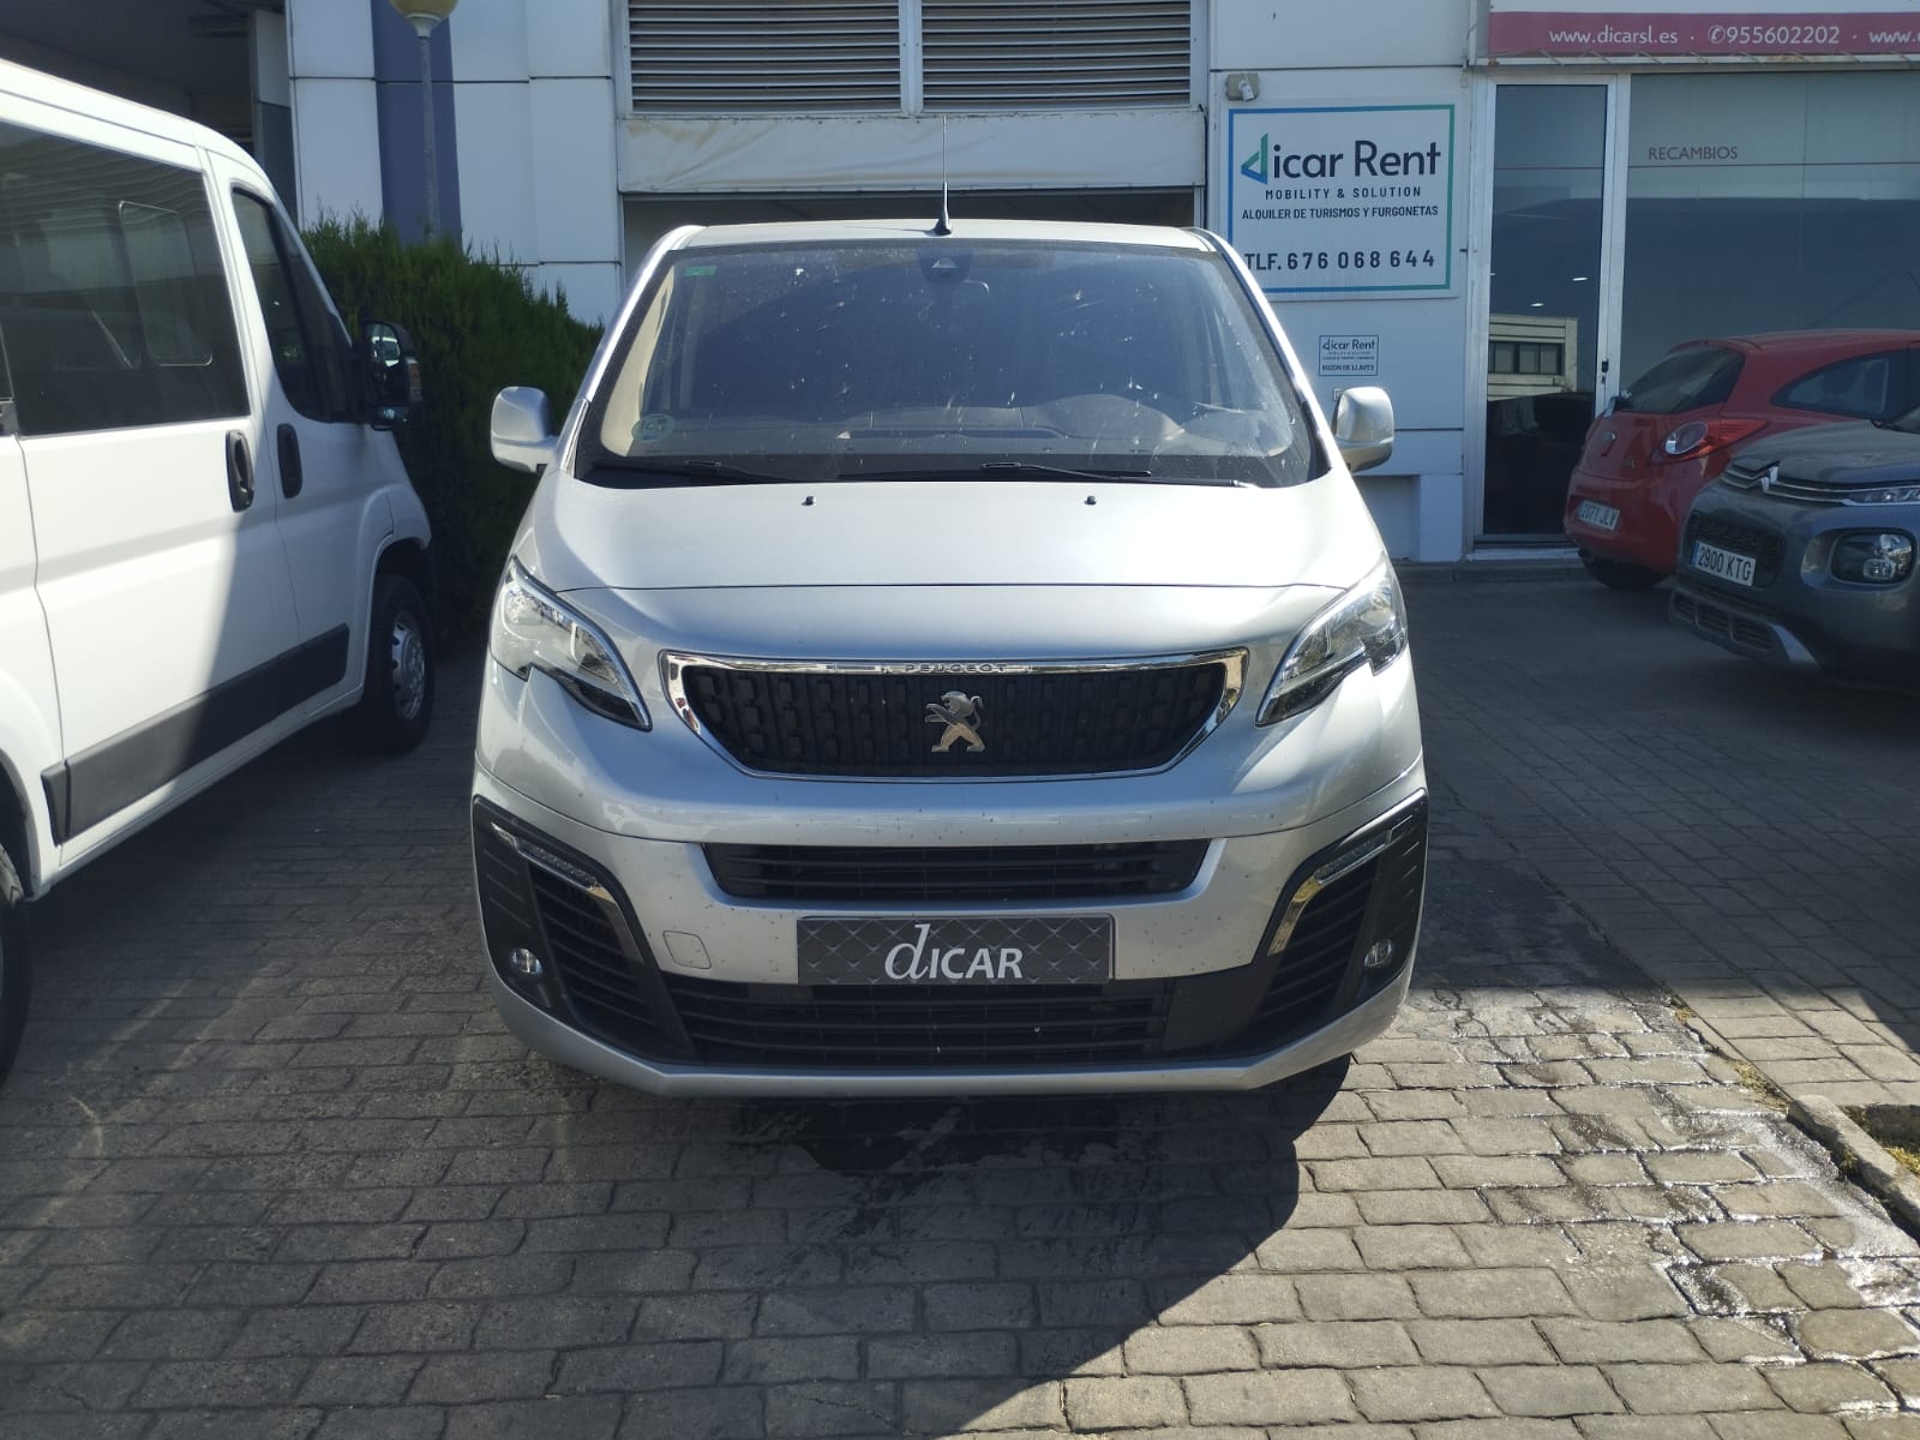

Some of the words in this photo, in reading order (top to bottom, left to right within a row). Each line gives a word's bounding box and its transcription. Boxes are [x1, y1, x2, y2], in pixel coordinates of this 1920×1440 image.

[1549, 25, 1678, 43] www.dicarsl.es
[1726, 26, 1840, 44] 955602202
[1869, 31, 1920, 43] www.
[1354, 140, 1441, 177] Rent
[1648, 146, 1738, 160] RECAMBIOS
[1265, 188, 1330, 200] MOBILITY
[1337, 188, 1345, 199] &
[1353, 187, 1421, 198] SOLUTION
[1242, 208, 1291, 220] ALQUILER
[1293, 208, 1306, 219] DE
[1309, 207, 1360, 218] TURISMOS
[1363, 207, 1369, 217] Y
[1372, 205, 1439, 217] FURGONETAS
[1245, 253, 1282, 270] TLF.
[1287, 252, 1329, 270] 676
[1337, 251, 1381, 269] 068
[1390, 249, 1435, 268] 644
[1352, 339, 1375, 350] Rent
[1698, 545, 1724, 573] 2900
[1727, 555, 1752, 581] KTG
[904, 663, 1008, 673] PEUGEOT
